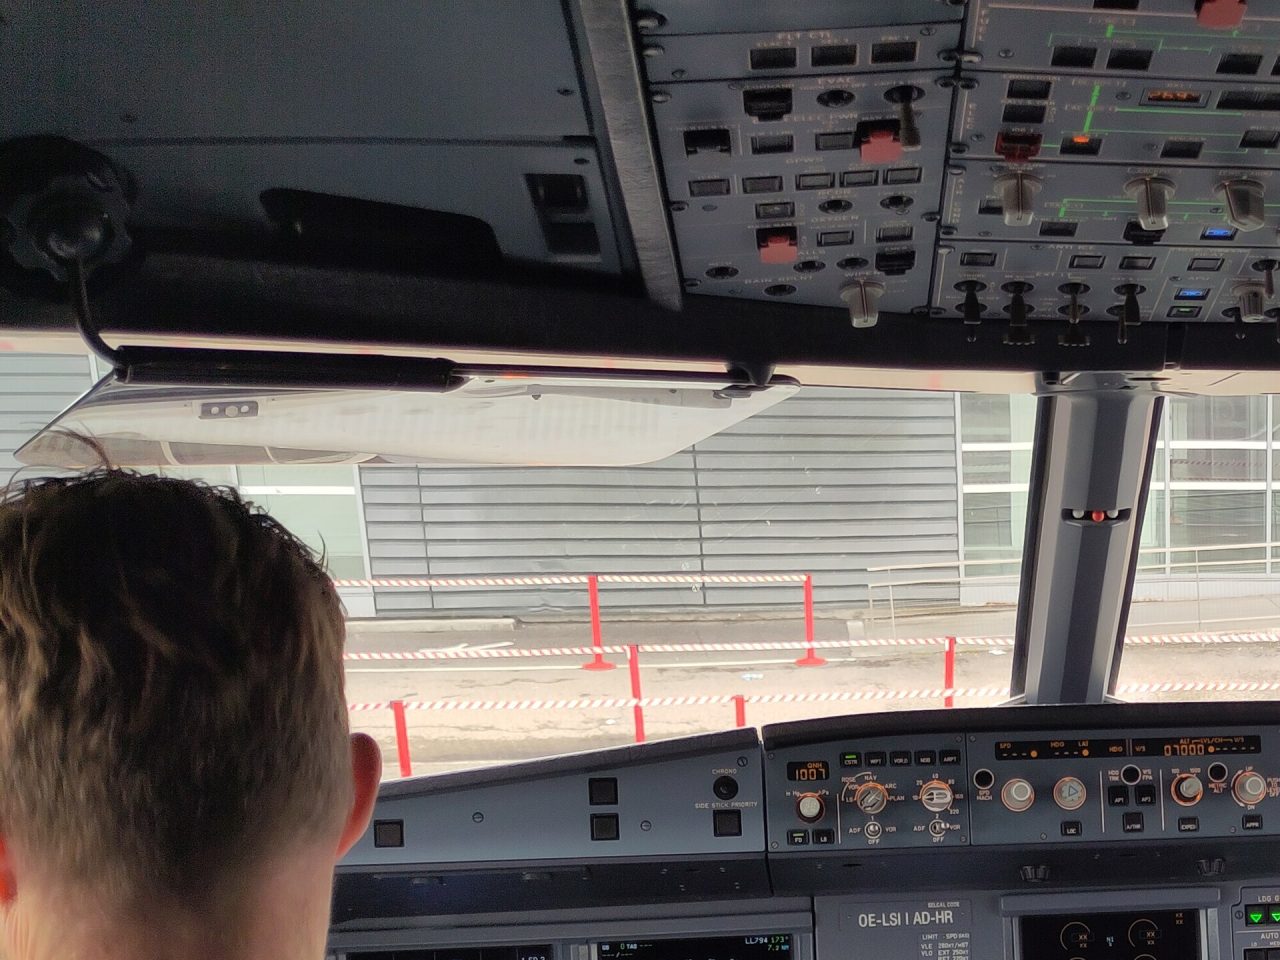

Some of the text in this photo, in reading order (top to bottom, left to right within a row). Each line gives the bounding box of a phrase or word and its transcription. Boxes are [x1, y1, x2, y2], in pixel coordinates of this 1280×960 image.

[1164, 745, 1204, 756] 07000
[795, 768, 826, 780] 1007
[858, 912, 901, 927] OE-LSI
[913, 911, 953, 925] AD-HR
